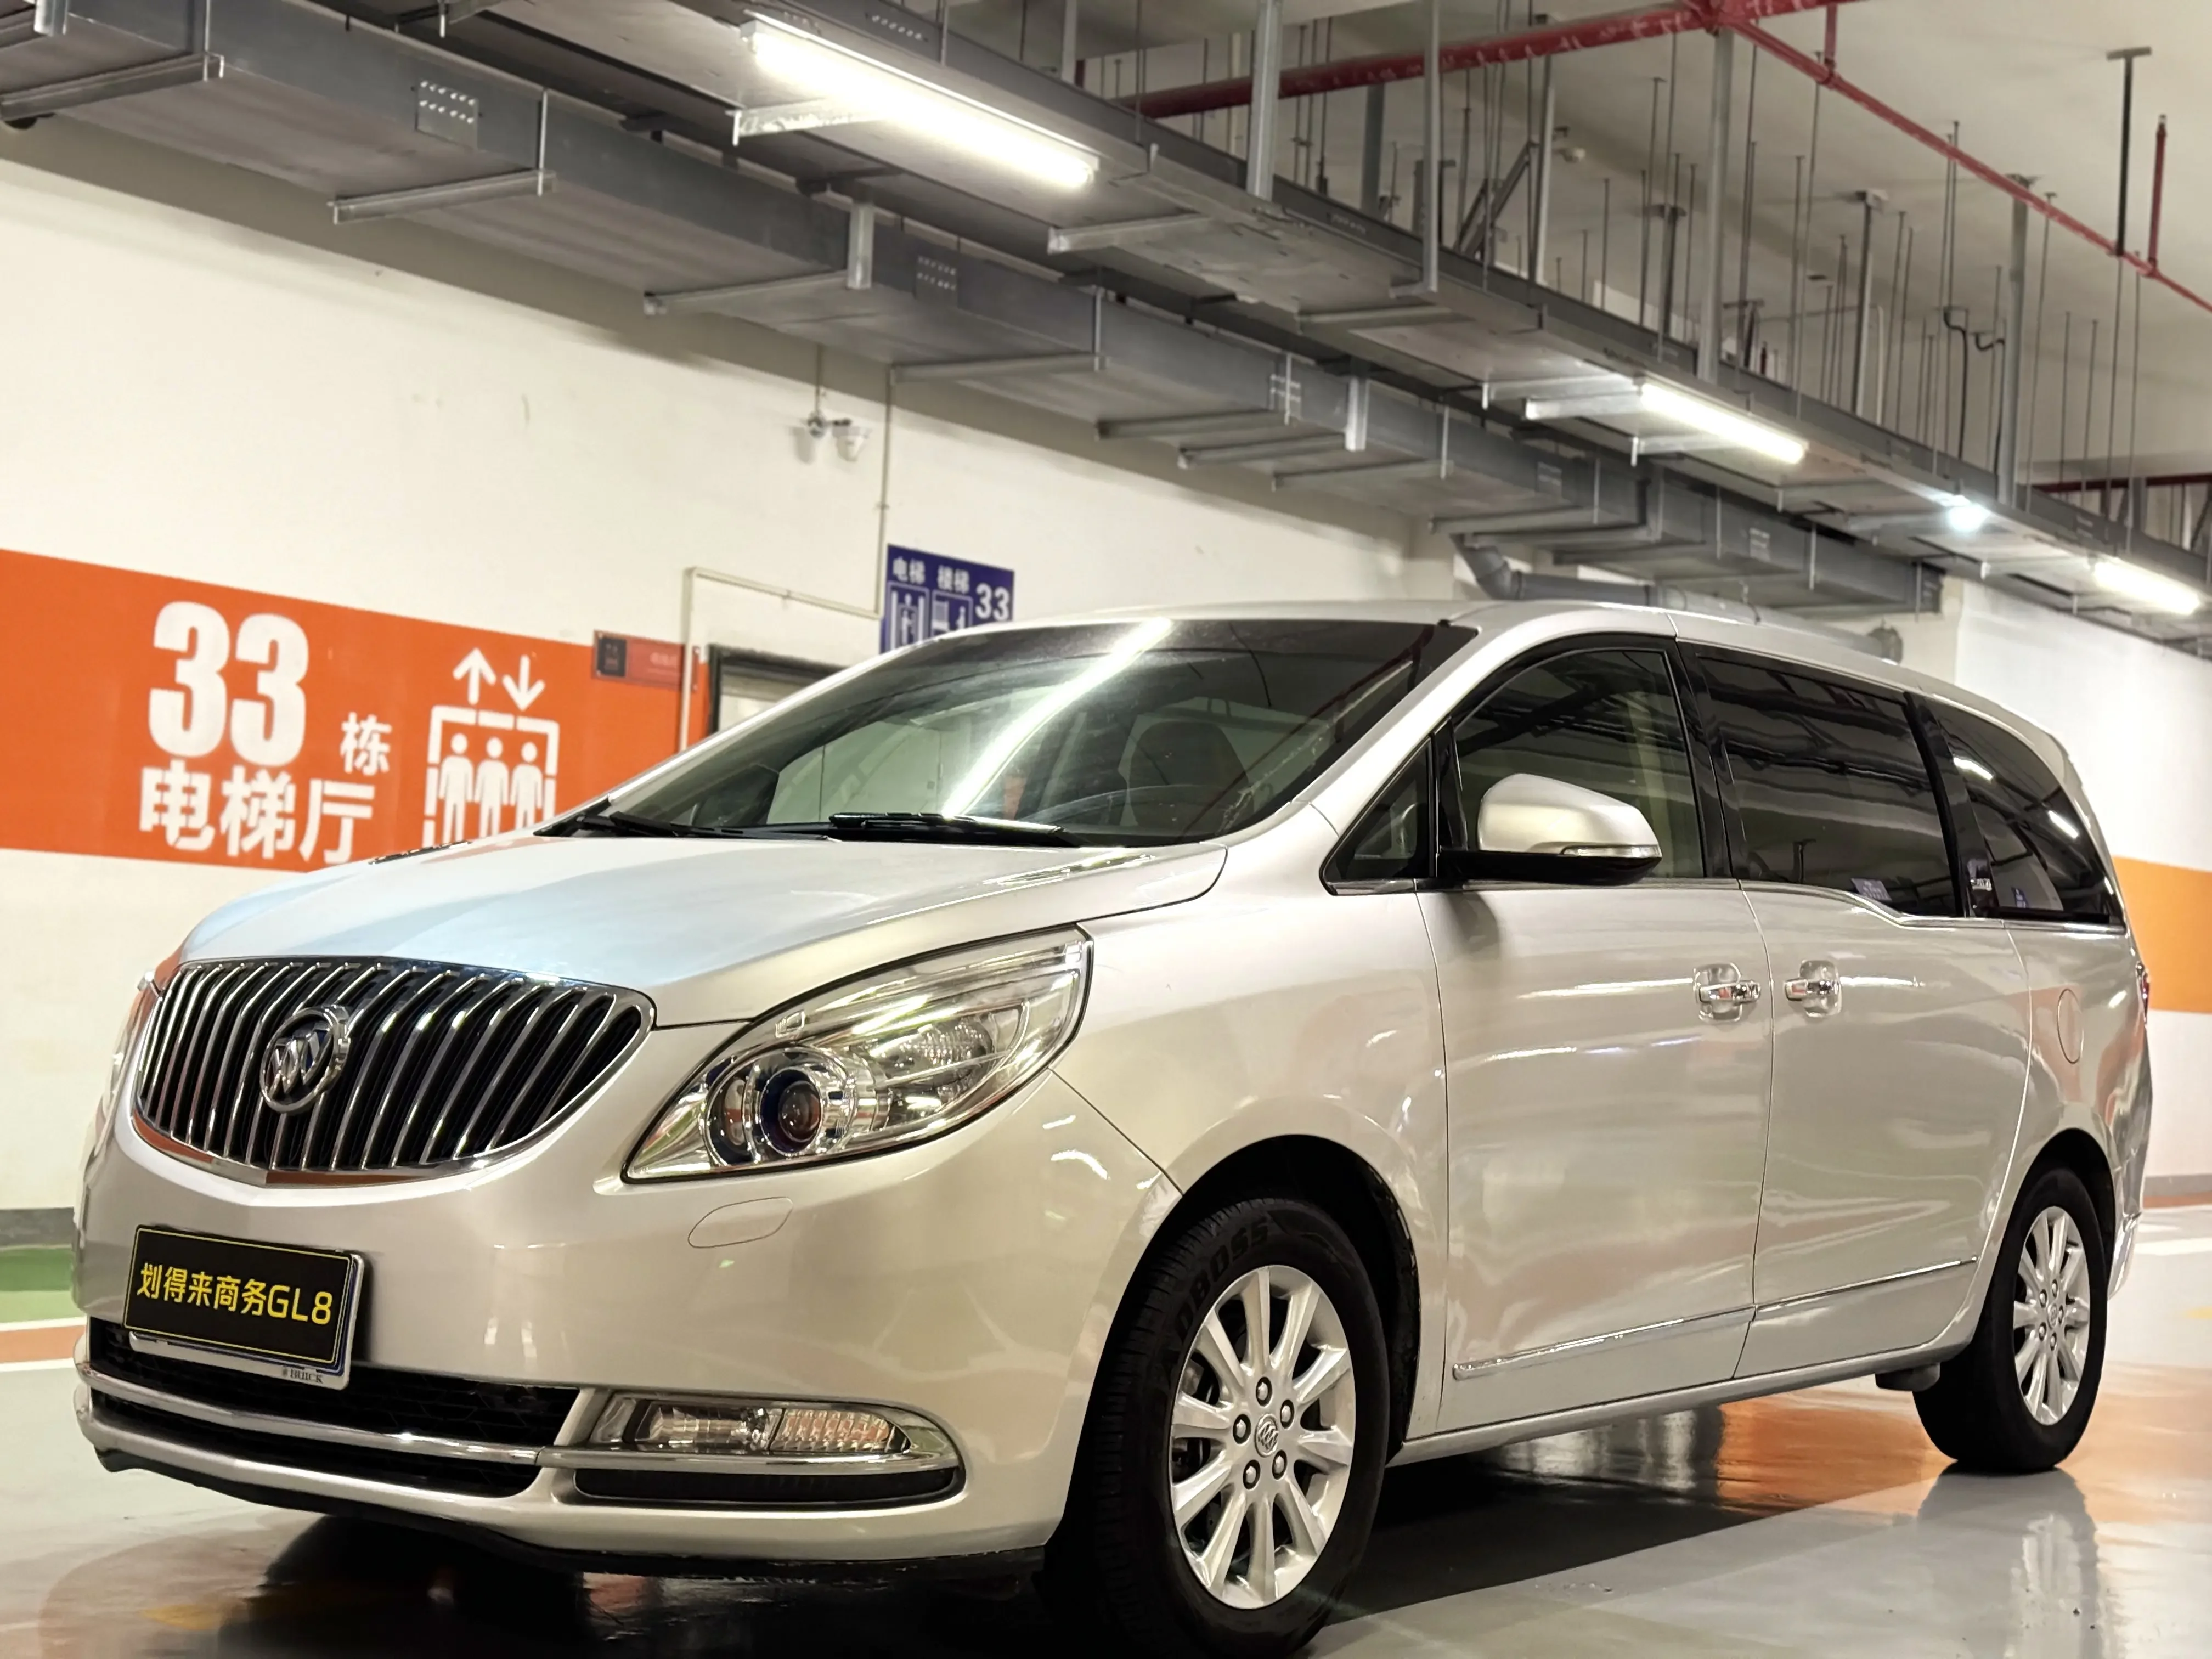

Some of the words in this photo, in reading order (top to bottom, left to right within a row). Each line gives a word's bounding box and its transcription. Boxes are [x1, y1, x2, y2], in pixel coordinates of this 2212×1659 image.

[975, 582, 1011, 622] 33
[148, 601, 309, 767] 33
[340, 712, 392, 776] 栋
[139, 759, 376, 865] 电梯厅
[137, 1262, 333, 1325] 划得来商务GL8
